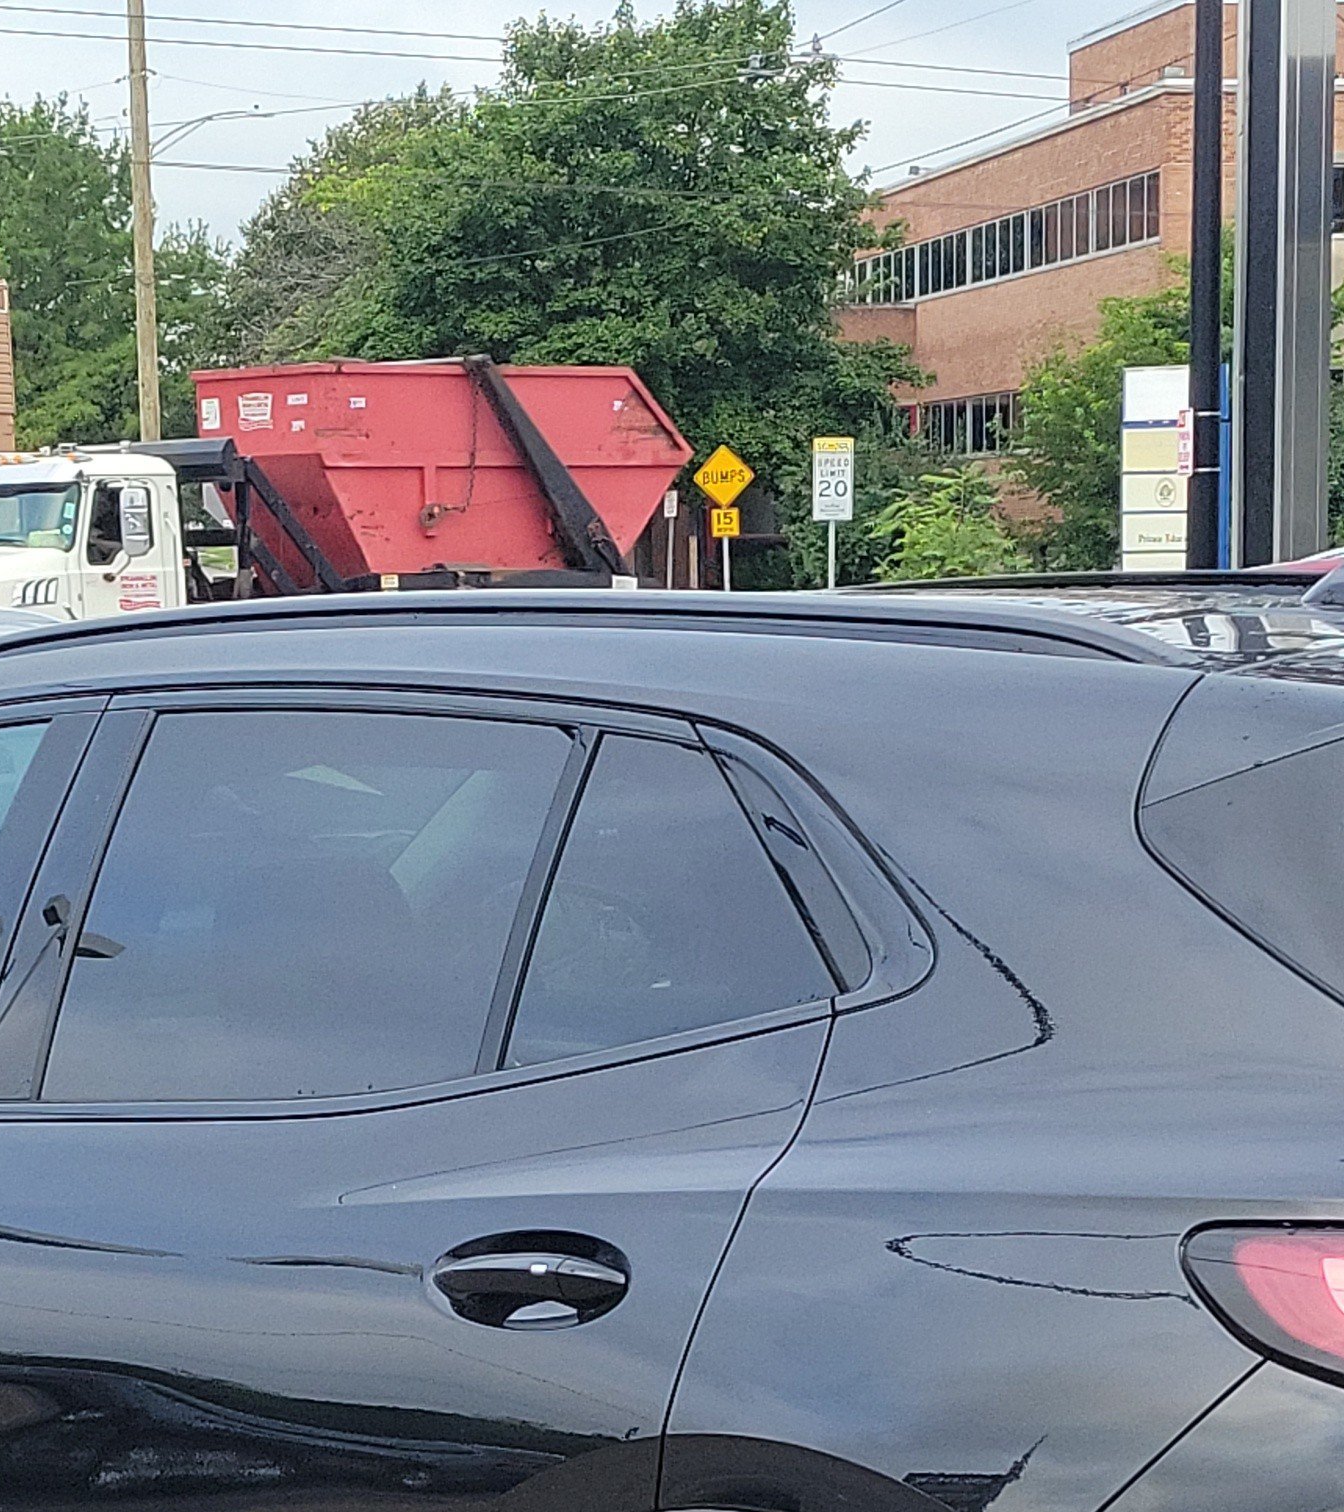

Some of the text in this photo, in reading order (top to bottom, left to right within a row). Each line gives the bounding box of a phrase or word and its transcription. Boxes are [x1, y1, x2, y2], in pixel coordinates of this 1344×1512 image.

[817, 458, 849, 467] SPEED
[702, 469, 745, 485] BUMPS
[820, 469, 845, 478] LIMIT
[819, 480, 848, 497] 20
[717, 512, 733, 525] 15
